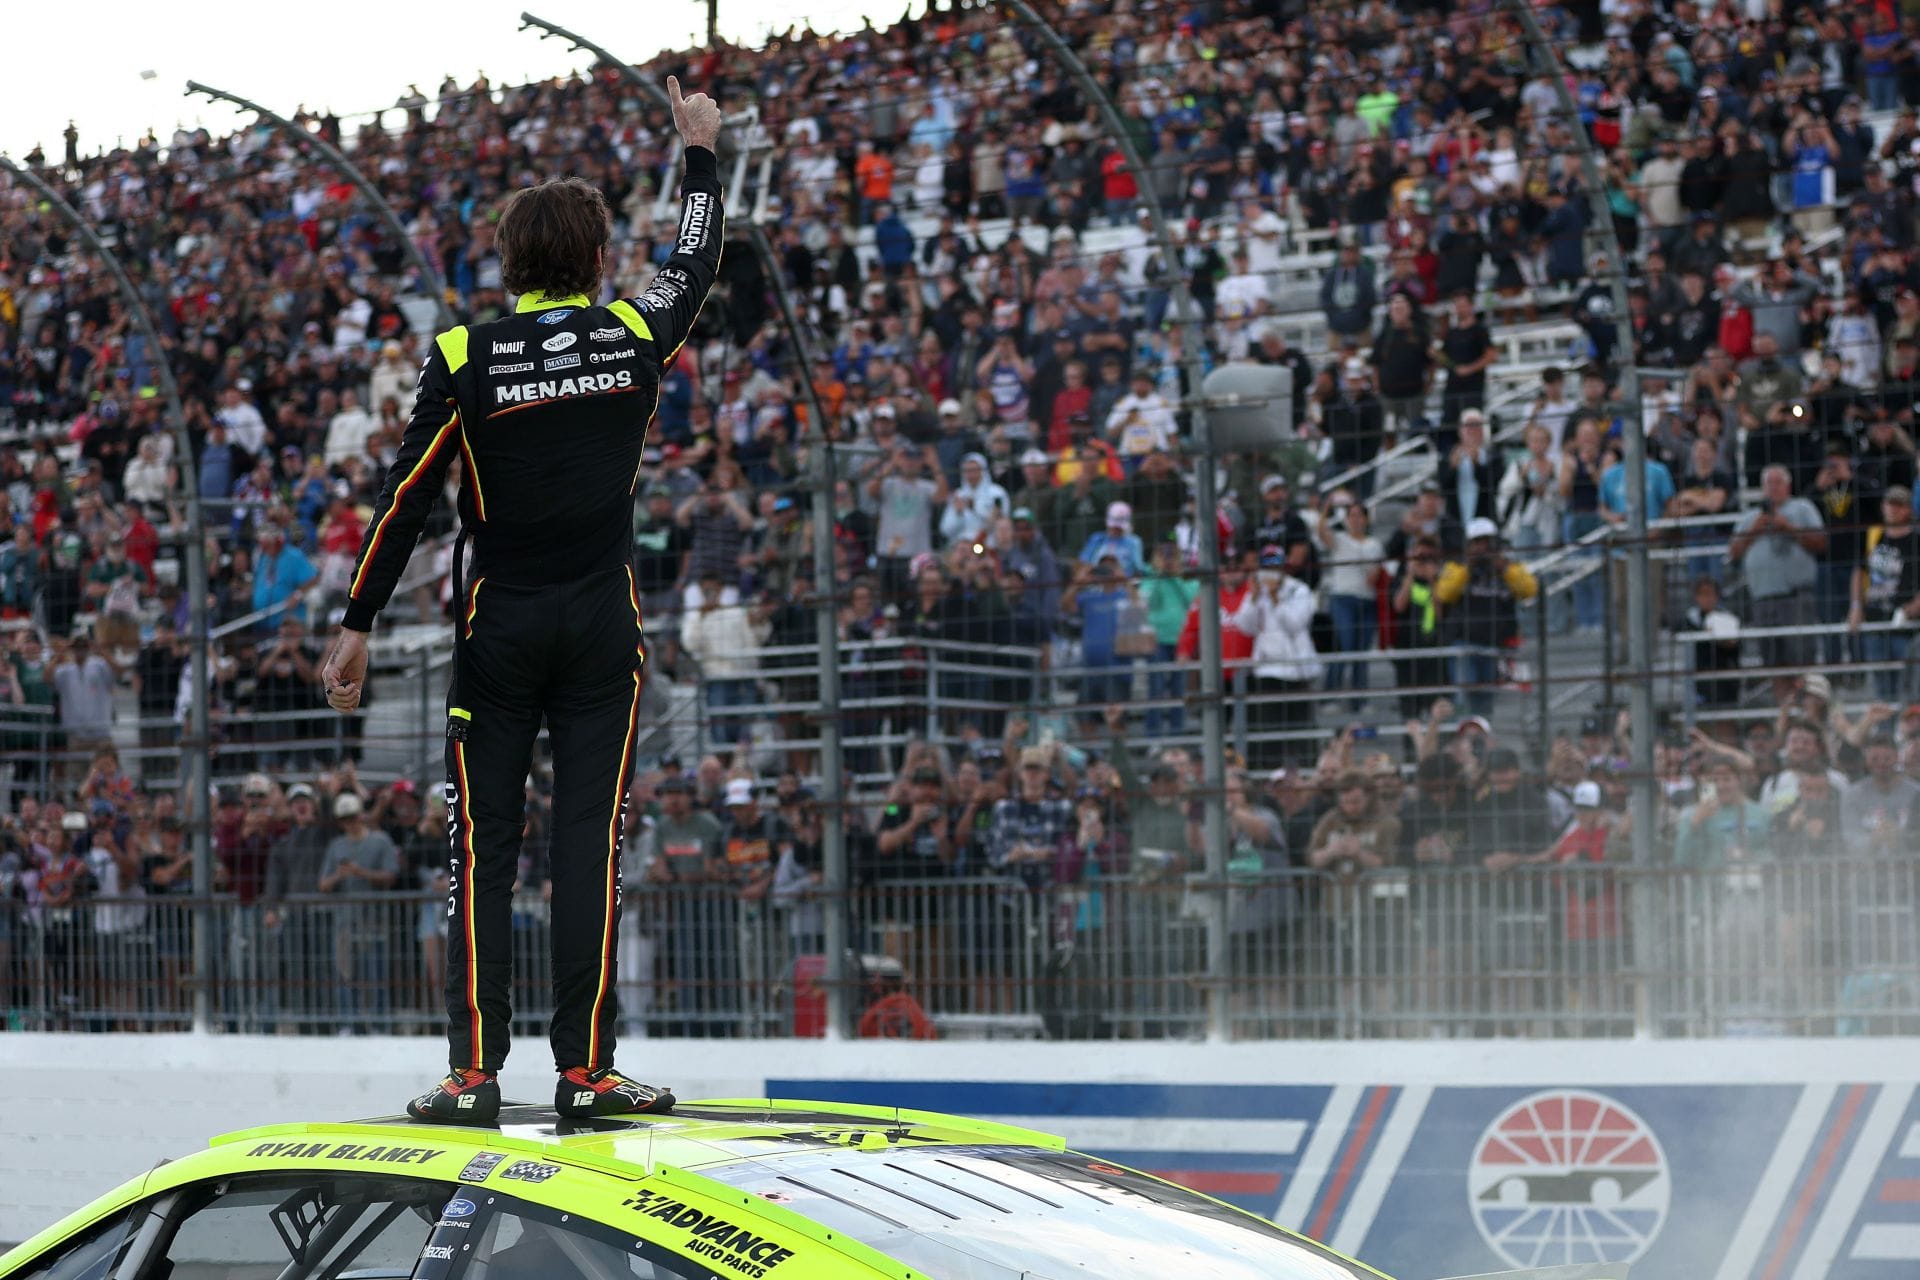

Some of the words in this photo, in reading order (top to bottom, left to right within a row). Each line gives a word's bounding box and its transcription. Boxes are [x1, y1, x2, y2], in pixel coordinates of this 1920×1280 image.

[678, 192, 708, 255] Richmond
[544, 313, 569, 324] Ford
[590, 327, 626, 341] Richmond
[492, 341, 526, 355] KNAUF
[547, 335, 572, 348] Scotts
[546, 356, 579, 369] MAYTAG
[600, 349, 636, 362] Tarkett
[490, 363, 533, 374] FROGTAPE
[496, 370, 632, 403] MENARDS
[457, 1094, 476, 1109] 12
[573, 1091, 595, 1106] 12
[247, 1143, 331, 1158] RYAN
[326, 1144, 447, 1164] BLANEY
[446, 1203, 468, 1214] Ford
[651, 1202, 795, 1268] ADVANCE
[685, 1239, 725, 1260] AUTO
[721, 1253, 767, 1279] PARTS
